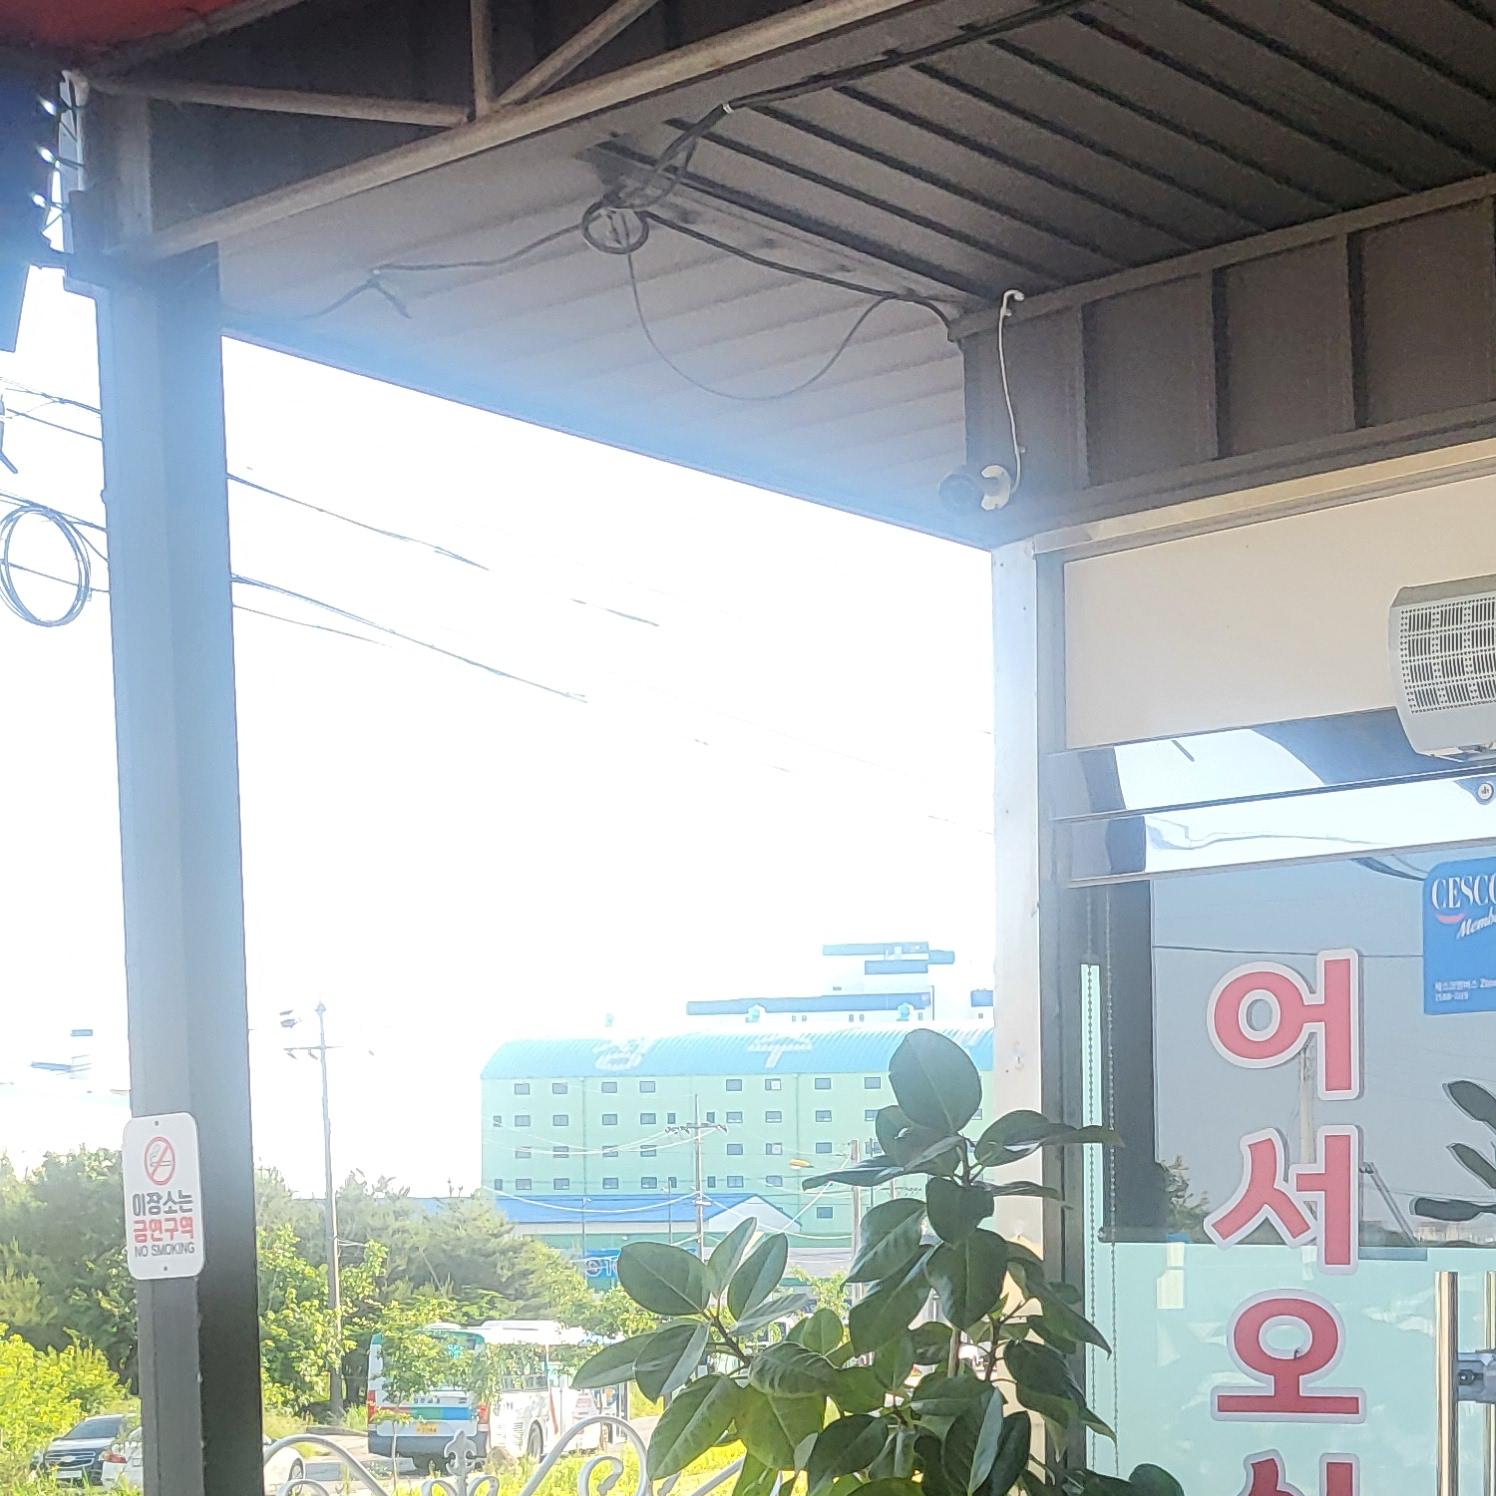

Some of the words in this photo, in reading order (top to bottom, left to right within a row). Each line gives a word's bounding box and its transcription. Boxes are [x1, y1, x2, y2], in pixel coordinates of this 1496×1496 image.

[133, 1217, 194, 1244] 금연구역
[134, 1246, 149, 1258] NO
[151, 1242, 195, 1257] SMOKING
